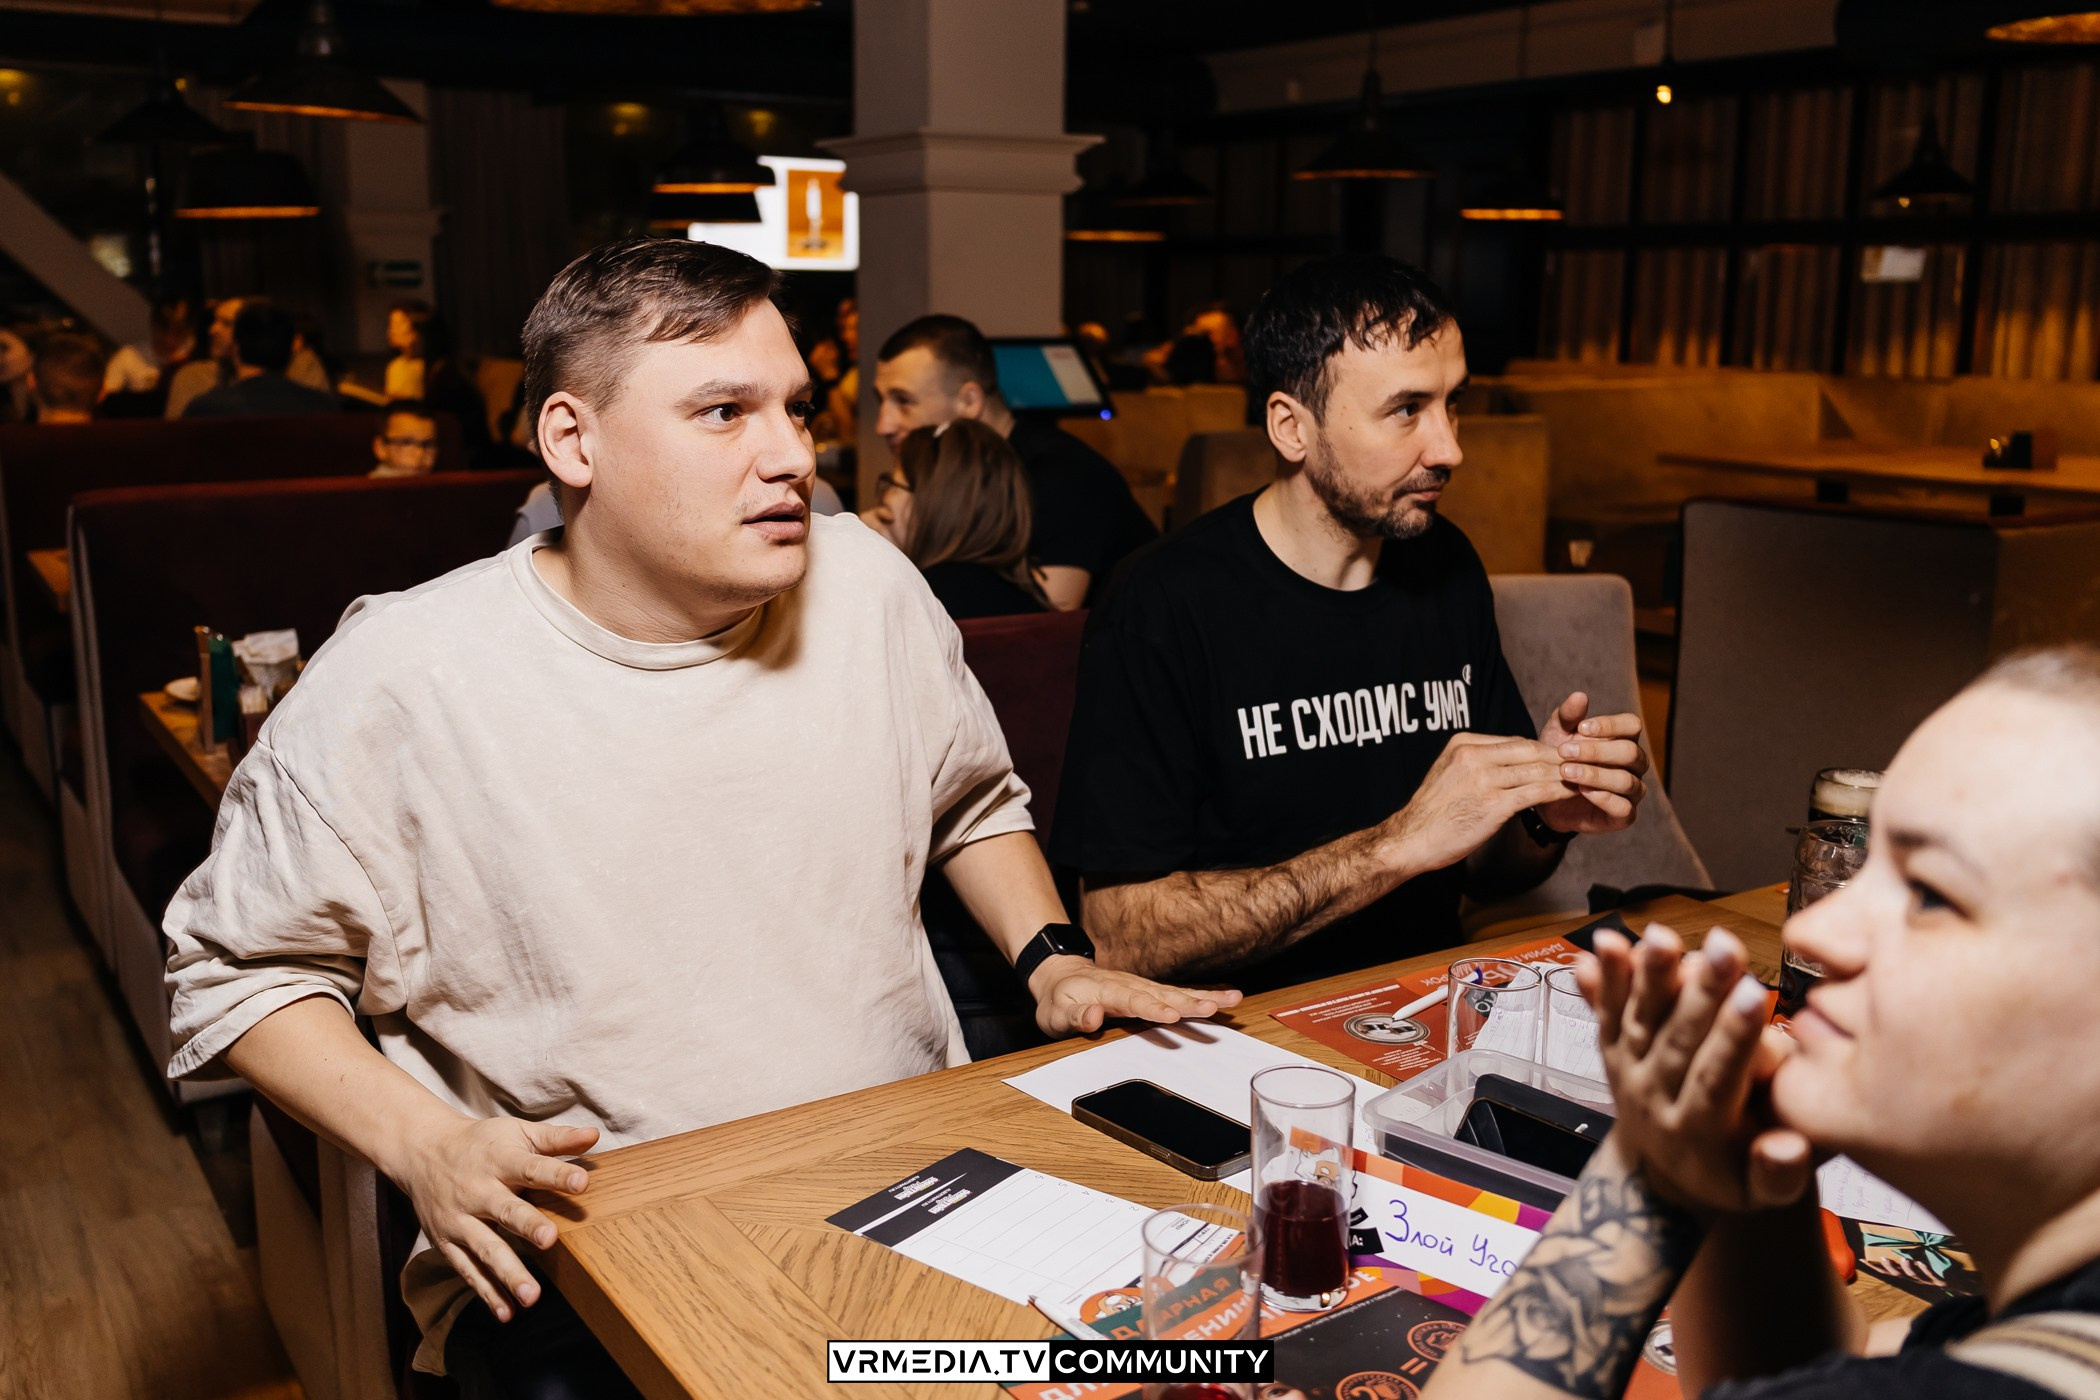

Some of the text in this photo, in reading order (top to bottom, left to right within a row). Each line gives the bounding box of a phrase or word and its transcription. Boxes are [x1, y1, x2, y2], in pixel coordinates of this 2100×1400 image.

[1237, 679, 1471, 760] НЕ СХОДИС УМА
[1385, 1199, 1519, 1278] Злой Уго
